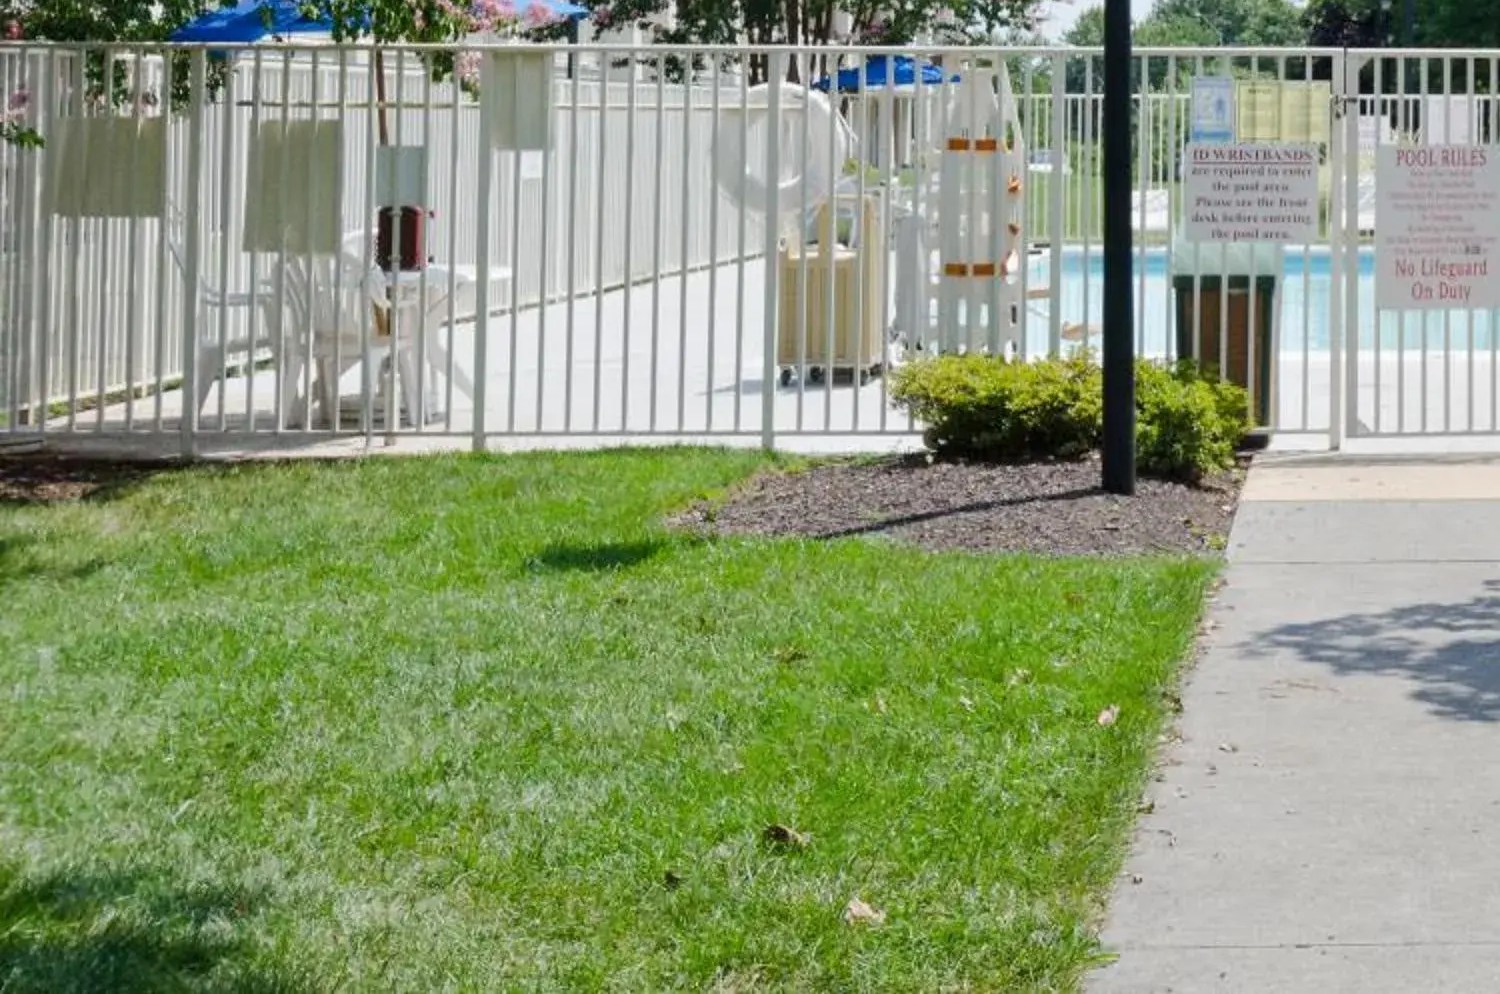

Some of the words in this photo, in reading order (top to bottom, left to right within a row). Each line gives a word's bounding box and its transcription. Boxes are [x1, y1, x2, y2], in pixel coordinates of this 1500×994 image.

[1193, 149, 1210, 161] ID
[1213, 149, 1313, 161] WRISTBANDS
[1396, 149, 1437, 167] POOL
[1441, 149, 1487, 167] RULES
[1213, 166, 1265, 179] required
[1211, 181, 1229, 192] the
[1233, 181, 1260, 193] pool
[1195, 196, 1233, 208] Please
[1256, 196, 1274, 208] the
[1221, 212, 1258, 223] before
[1232, 228, 1260, 242] pool
[1394, 258, 1415, 277] No
[1420, 258, 1488, 280] Lifeguard
[1411, 281, 1433, 300] On
[1438, 281, 1472, 303] Duty
